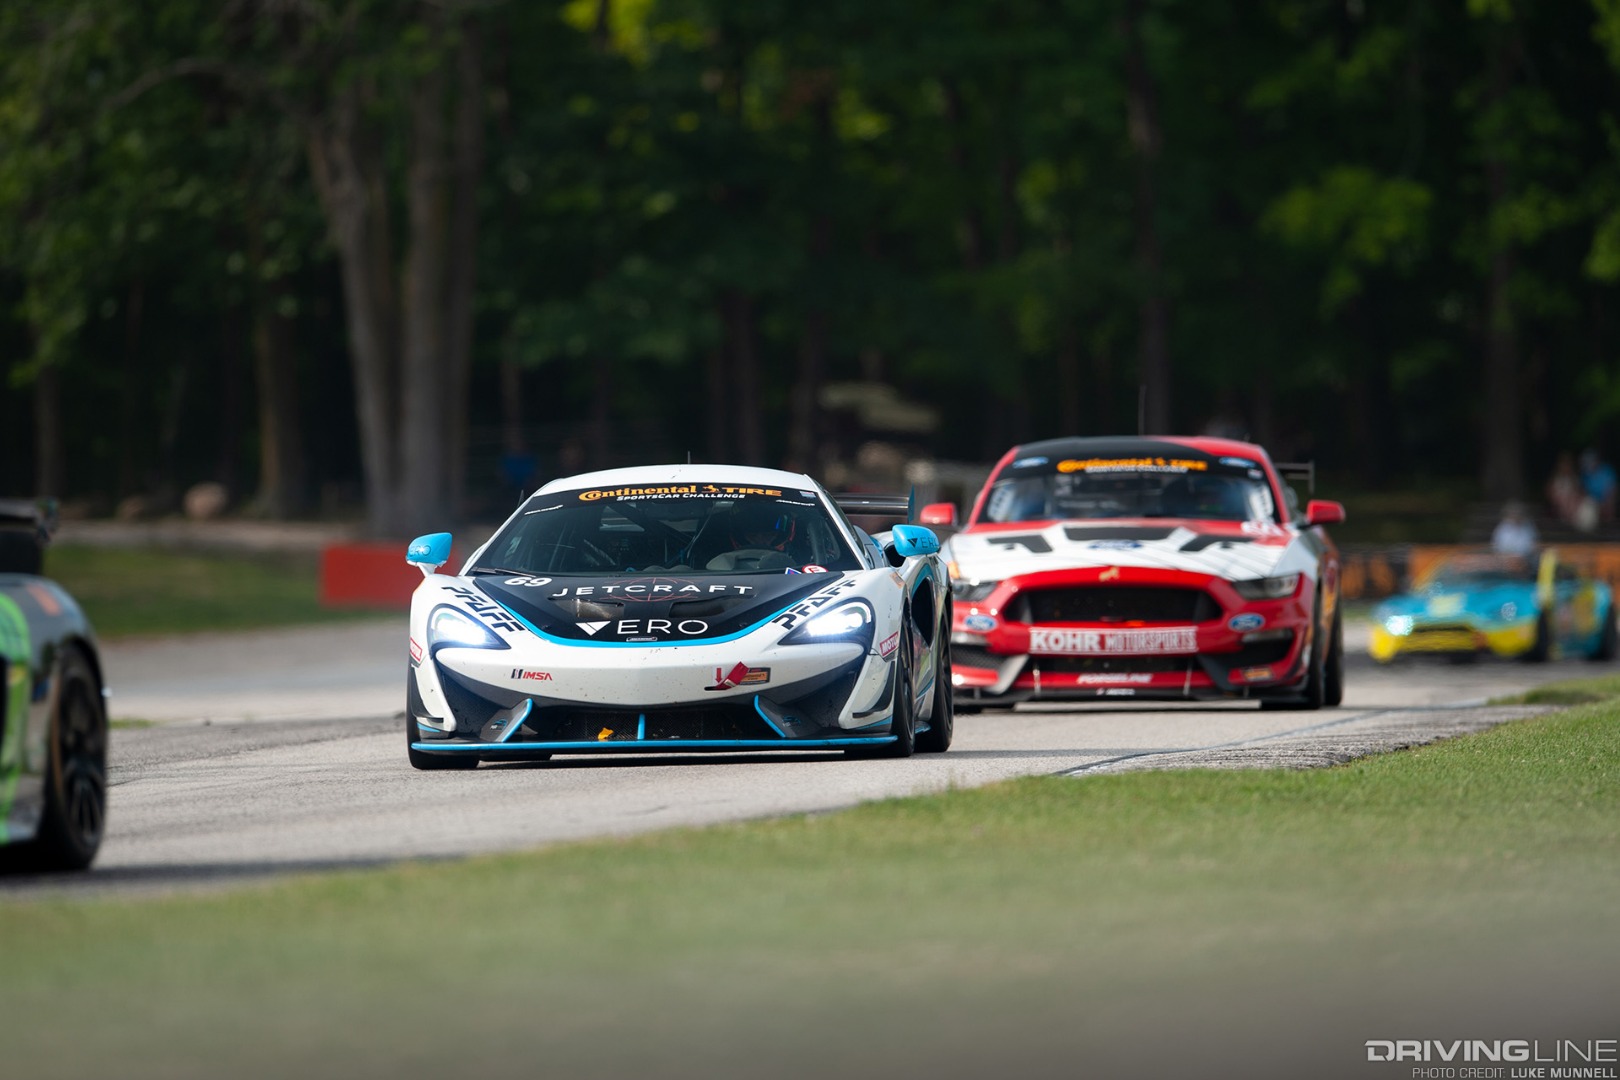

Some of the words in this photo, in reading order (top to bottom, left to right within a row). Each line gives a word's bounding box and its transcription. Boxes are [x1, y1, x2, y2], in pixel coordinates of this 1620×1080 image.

[578, 485, 697, 502] Continental
[722, 487, 782, 497] TIRE
[504, 576, 552, 587] 69
[552, 584, 753, 597] JETCRAFT
[1030, 630, 1101, 652] KOHR
[1105, 630, 1196, 652] MOTORSPORTS
[522, 671, 553, 681] IMSA
